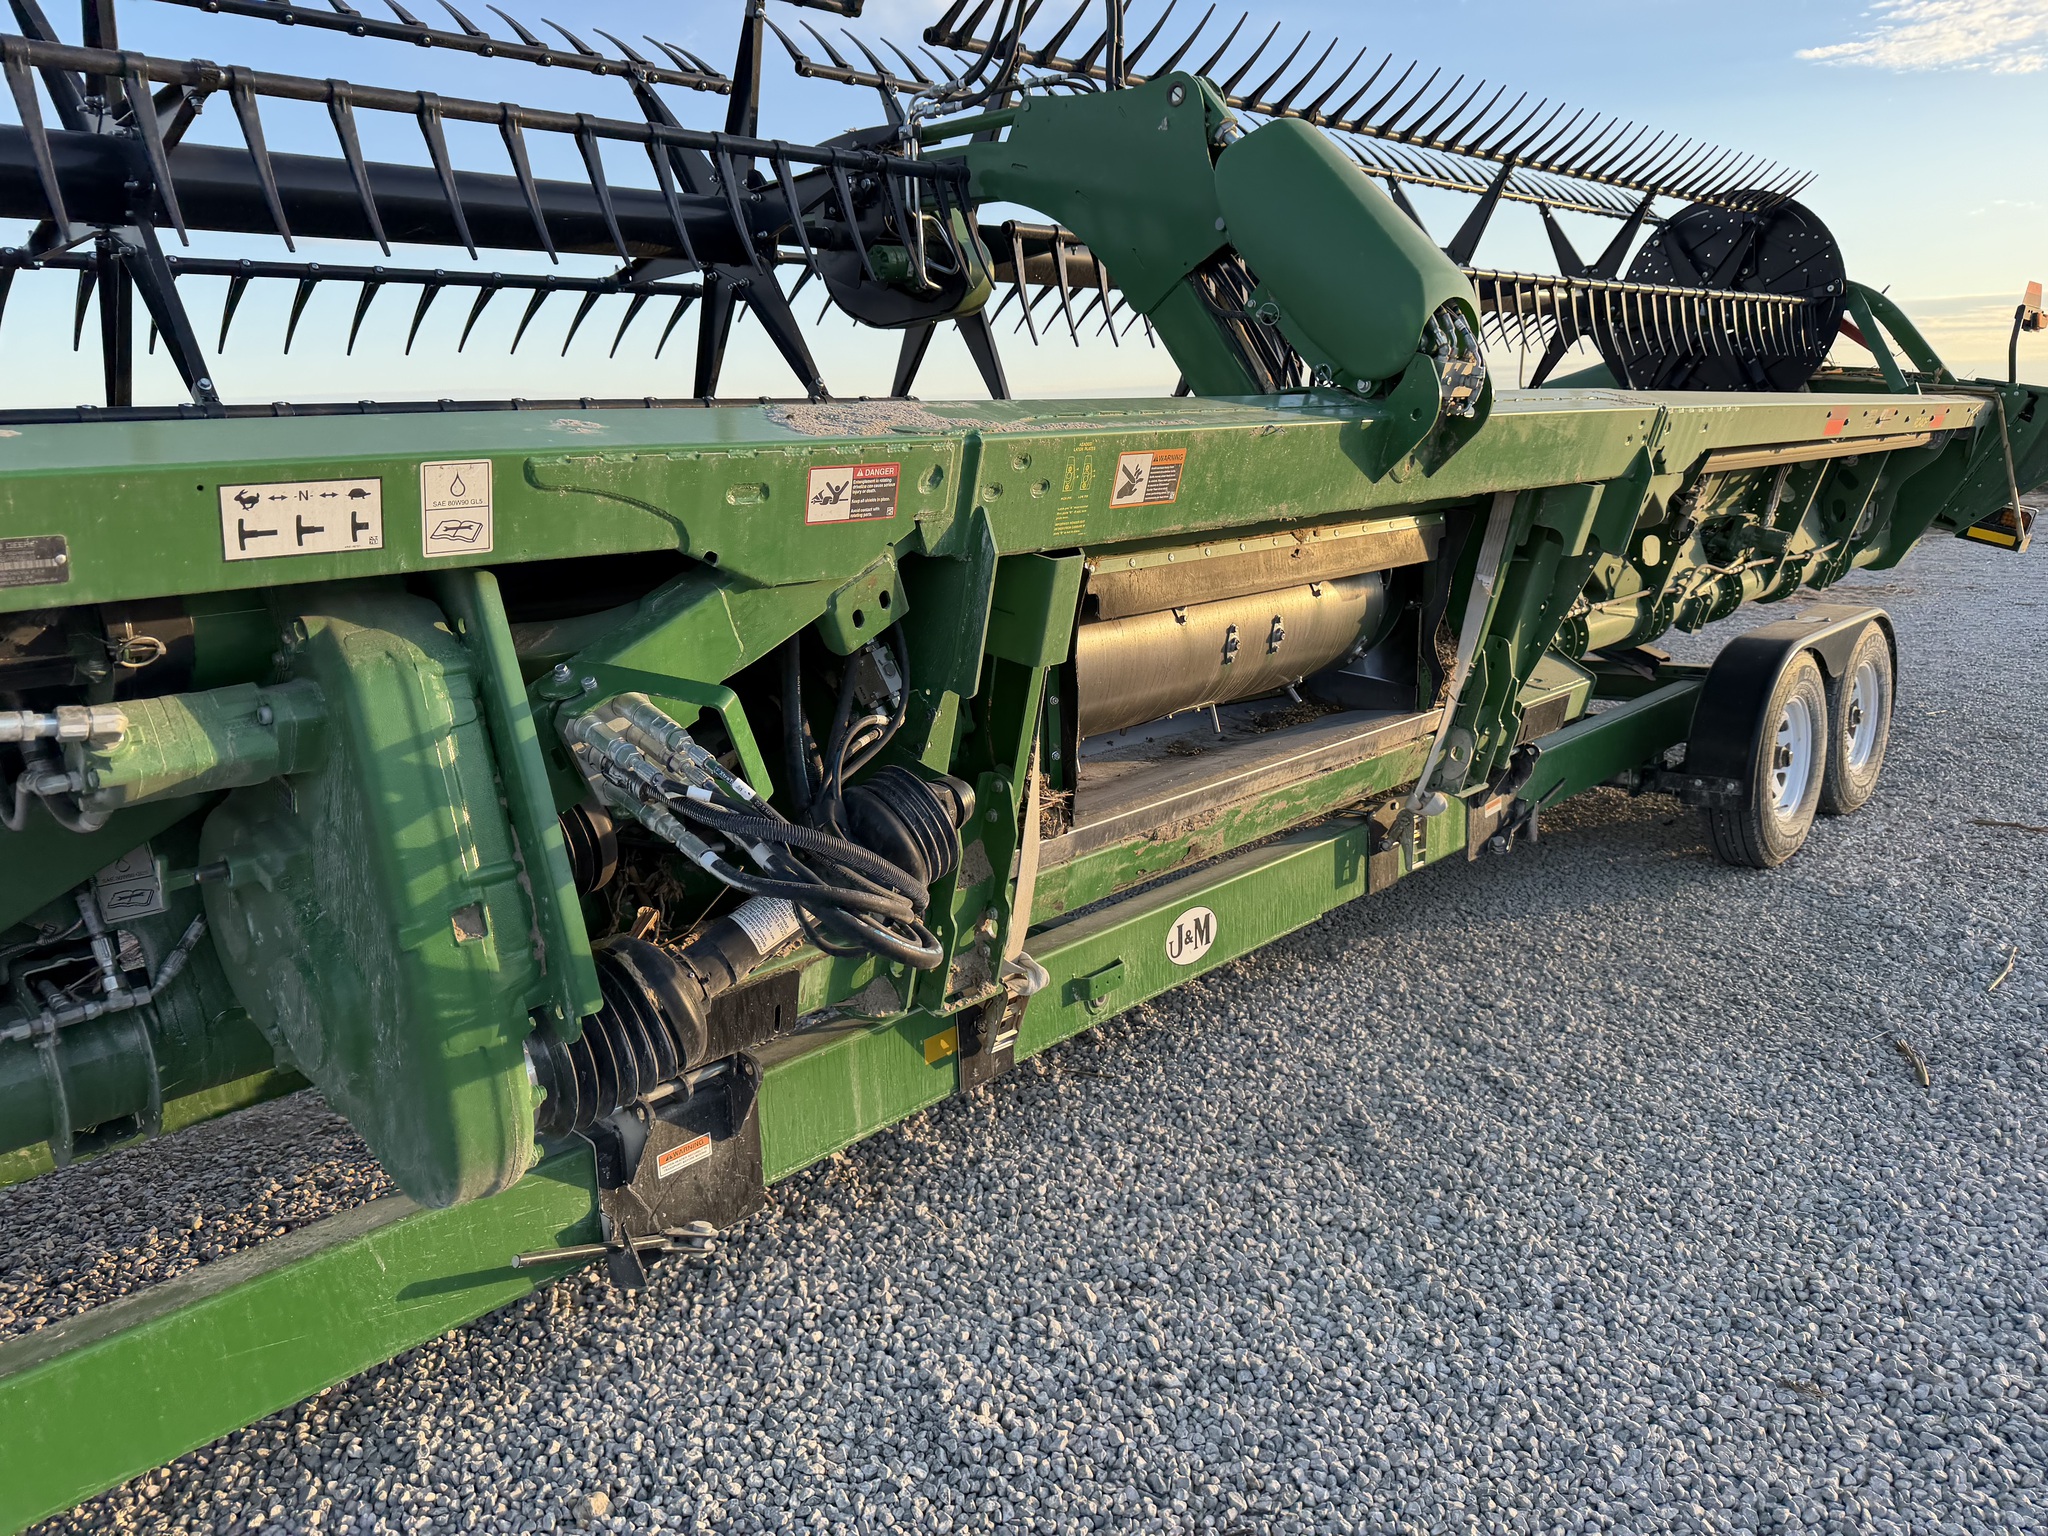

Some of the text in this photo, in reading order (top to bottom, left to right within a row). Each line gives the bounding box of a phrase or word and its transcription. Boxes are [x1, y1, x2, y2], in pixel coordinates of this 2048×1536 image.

[1159, 454, 1183, 462] WARNING
[865, 468, 894, 476] DANGER
[1169, 912, 1211, 959] J&M
[673, 1139, 704, 1157] WARNING
